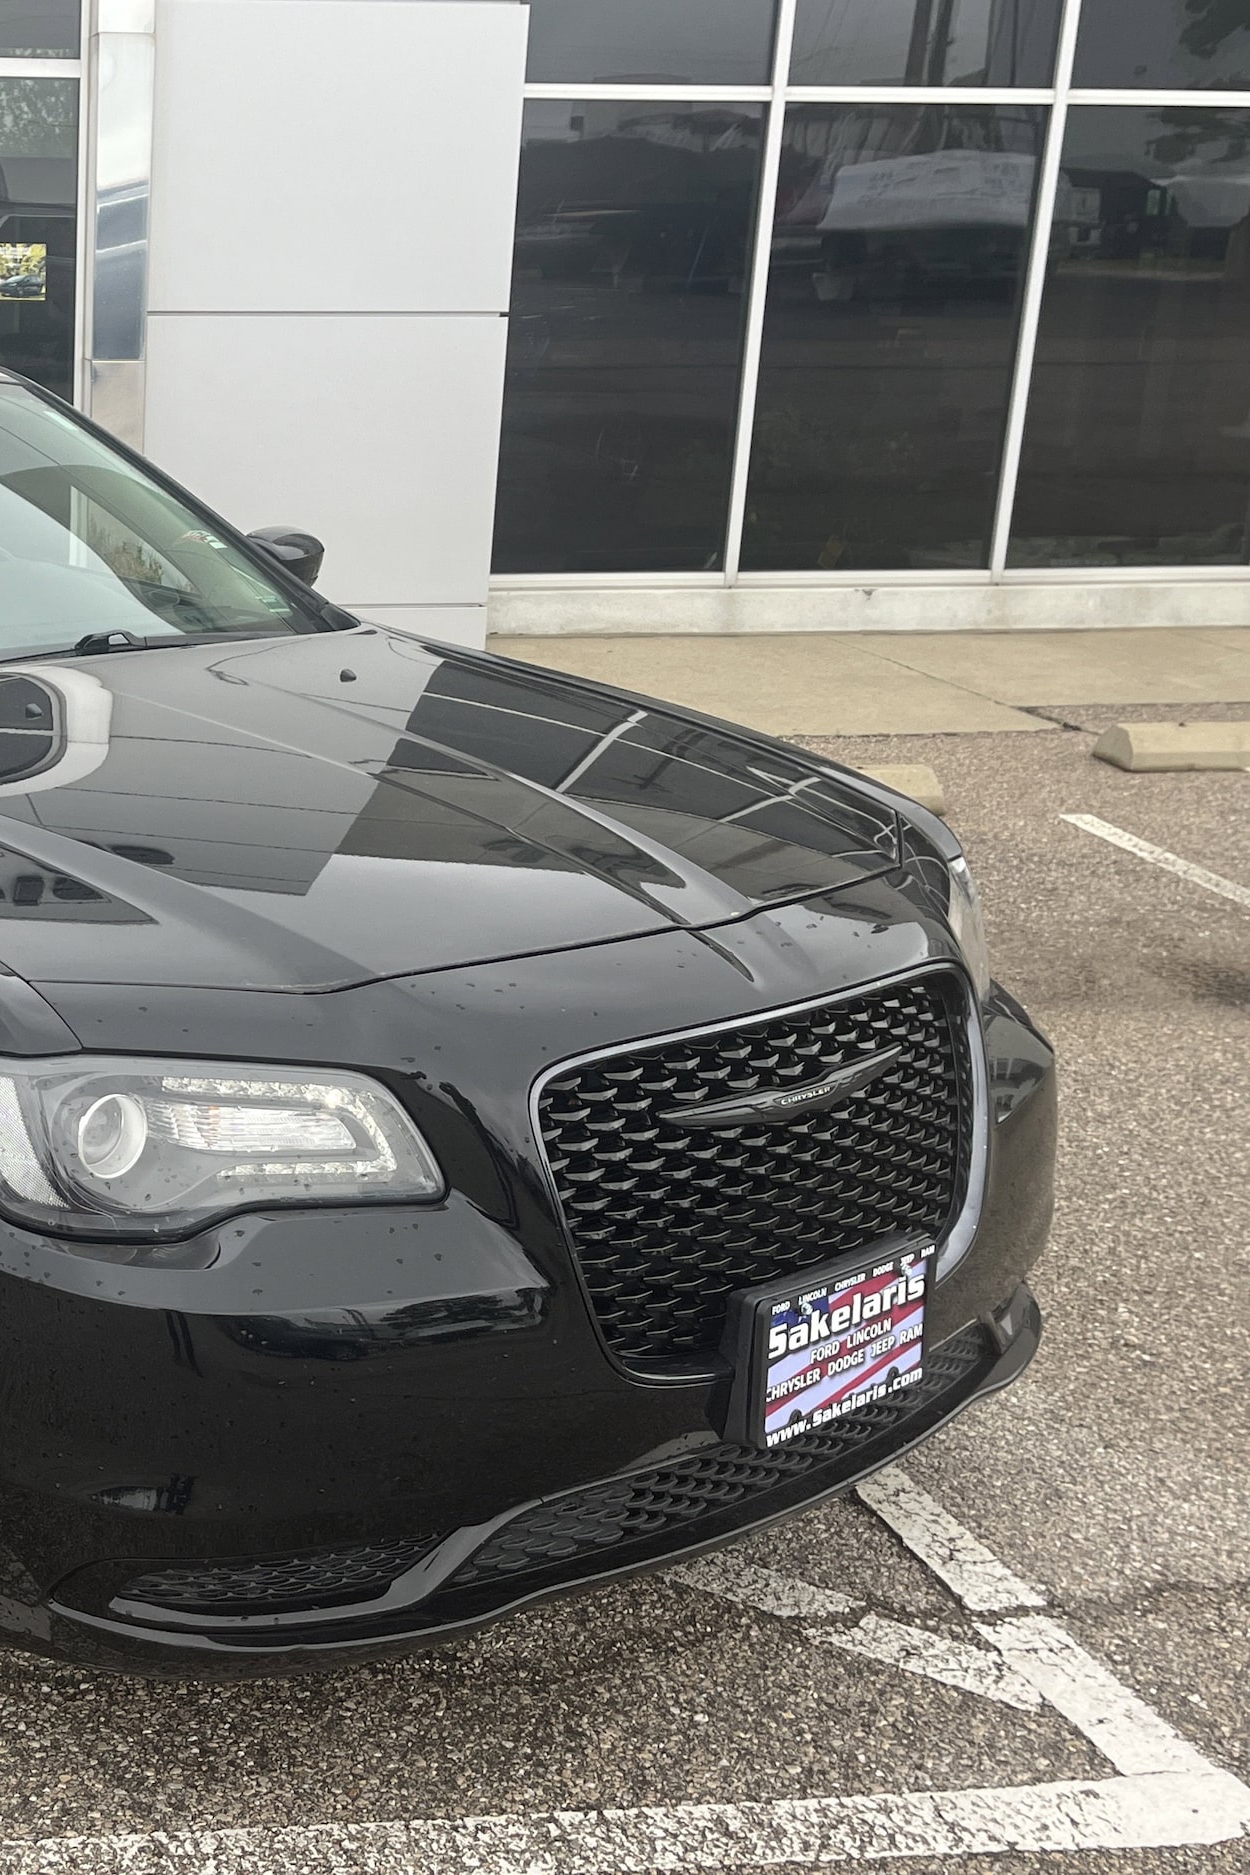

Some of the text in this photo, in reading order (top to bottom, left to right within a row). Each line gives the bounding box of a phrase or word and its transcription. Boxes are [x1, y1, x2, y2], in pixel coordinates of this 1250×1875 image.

[781, 1087, 831, 1105] CHRYSLER
[768, 1275, 926, 1360] Sakelaris
[771, 1245, 936, 1316] FORD LINCOLN CHRYSLER DODGE JEEP RAM
[766, 1323, 923, 1403] CHRYSLER DODGE JEEP RAM
[810, 1318, 892, 1364] FORD LINCOLN
[766, 1367, 923, 1448] www.Sakelaris.com
